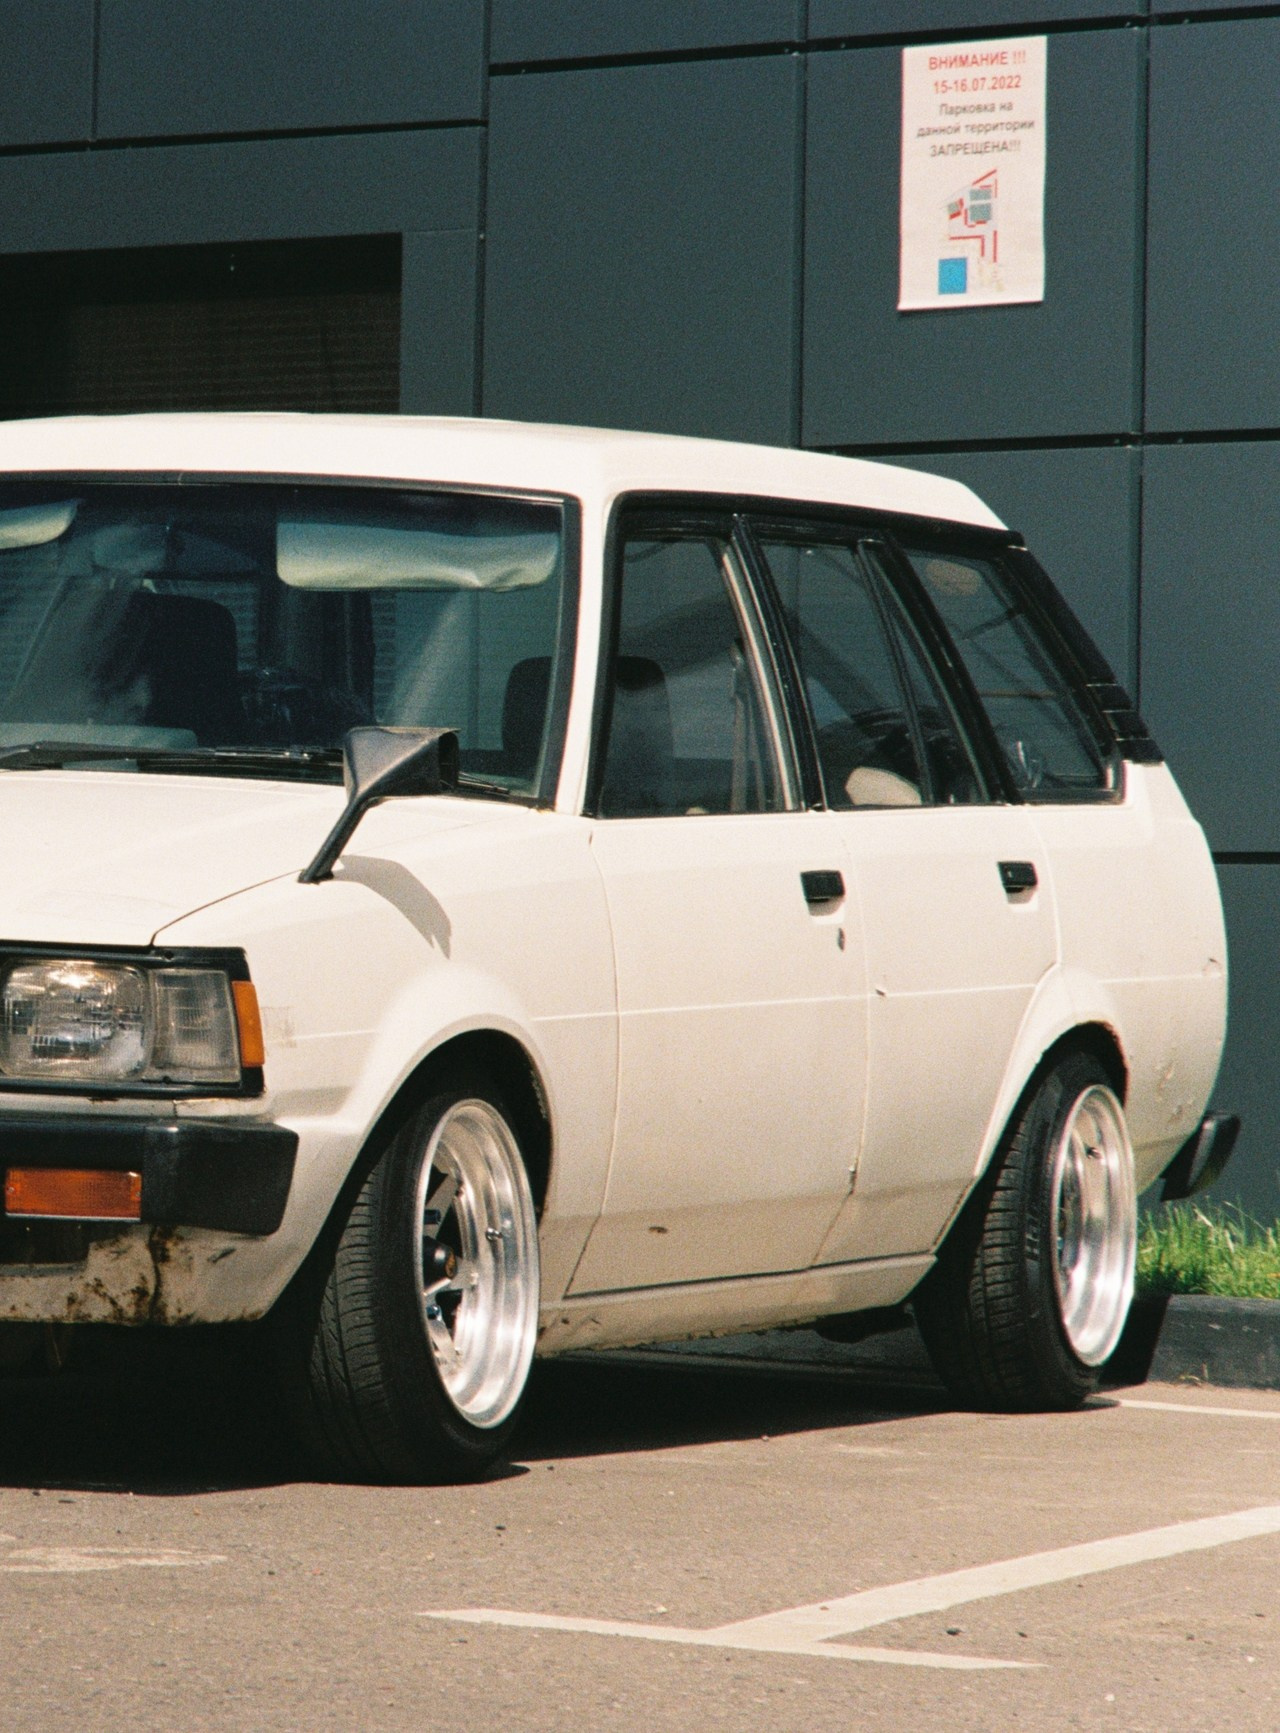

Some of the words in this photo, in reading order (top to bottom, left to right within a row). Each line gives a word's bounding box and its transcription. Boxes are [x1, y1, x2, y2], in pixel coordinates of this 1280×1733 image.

[928, 52, 1009, 71] ВНИМАНИЕ
[1013, 50, 1026, 65] !!!
[933, 75, 1022, 94] 15-16.07.2022
[939, 103, 996, 117] Парковка
[999, 103, 1014, 112] на
[916, 123, 961, 138] данной
[964, 121, 1035, 135] территории
[930, 140, 1021, 158] ЗАПРЕЩЕНА!!!
